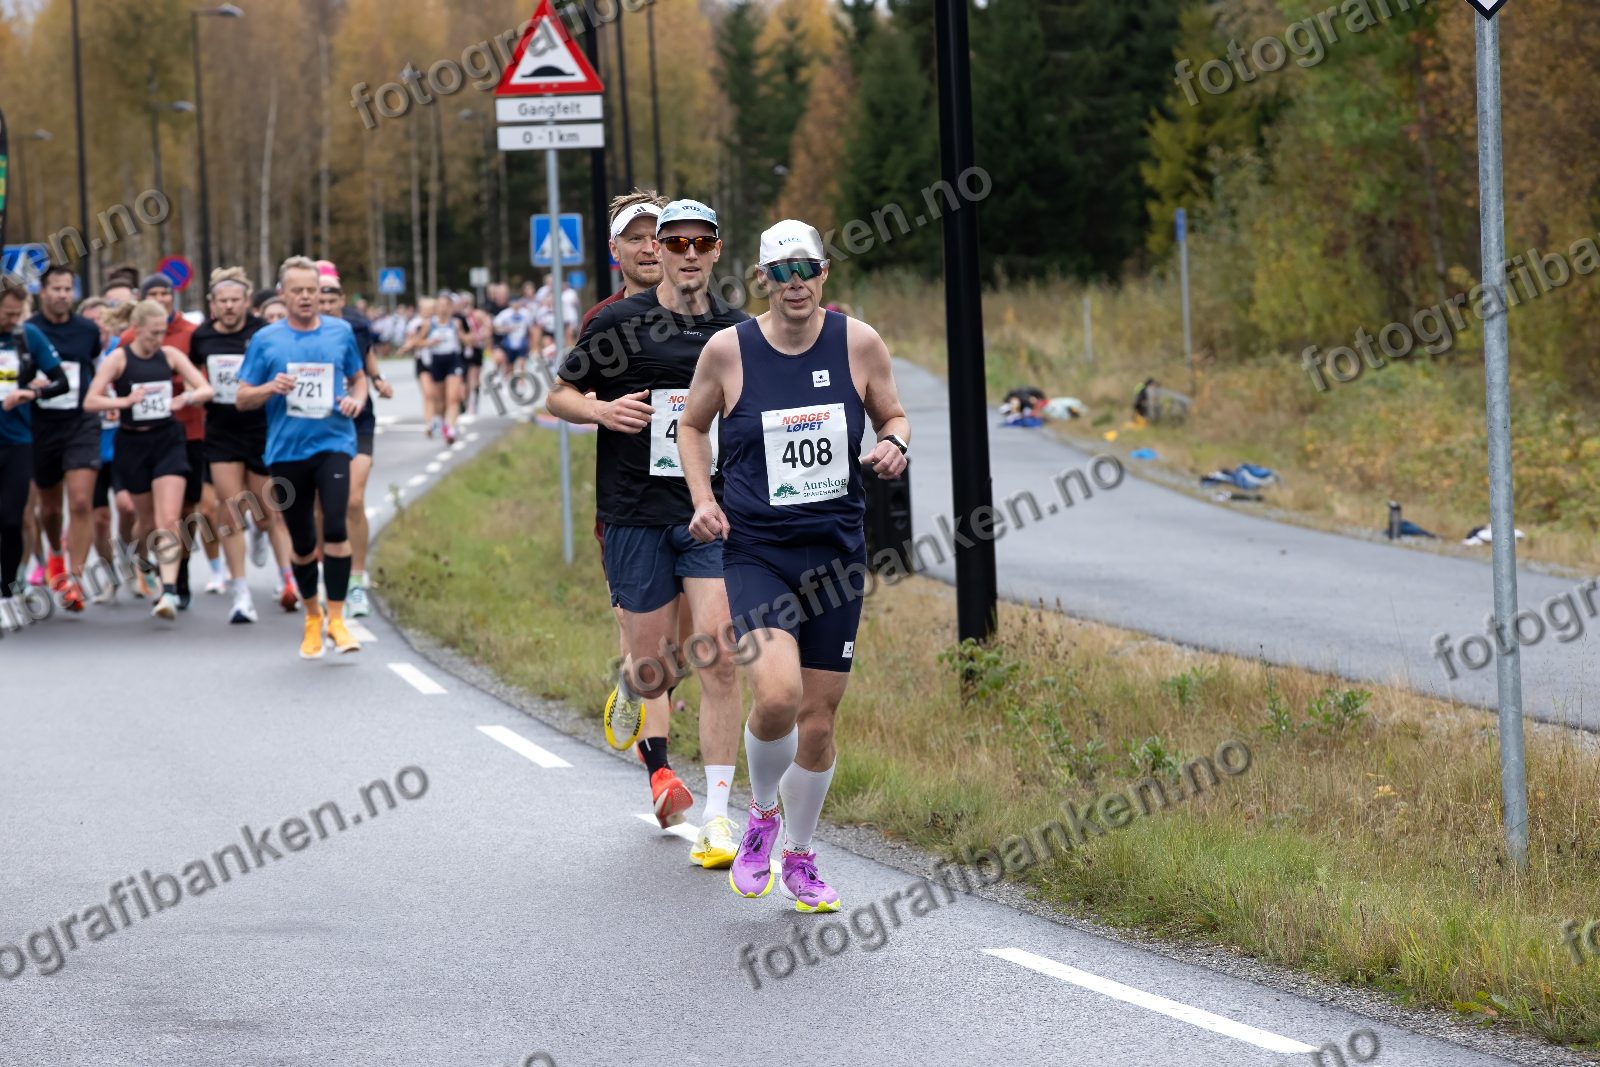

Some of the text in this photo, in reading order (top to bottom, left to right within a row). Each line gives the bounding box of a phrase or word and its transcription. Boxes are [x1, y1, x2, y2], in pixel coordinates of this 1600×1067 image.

[518, 103, 581, 117] Gangfelt
[522, 131, 533, 144] 0
[548, 130, 554, 143] 1
[557, 129, 579, 143] km
[296, 381, 322, 398] 721
[669, 395, 687, 404] NO
[782, 411, 830, 425] NORGES
[786, 421, 823, 433] LØPET
[782, 437, 832, 469] 408
[803, 477, 847, 491] Aurskog
